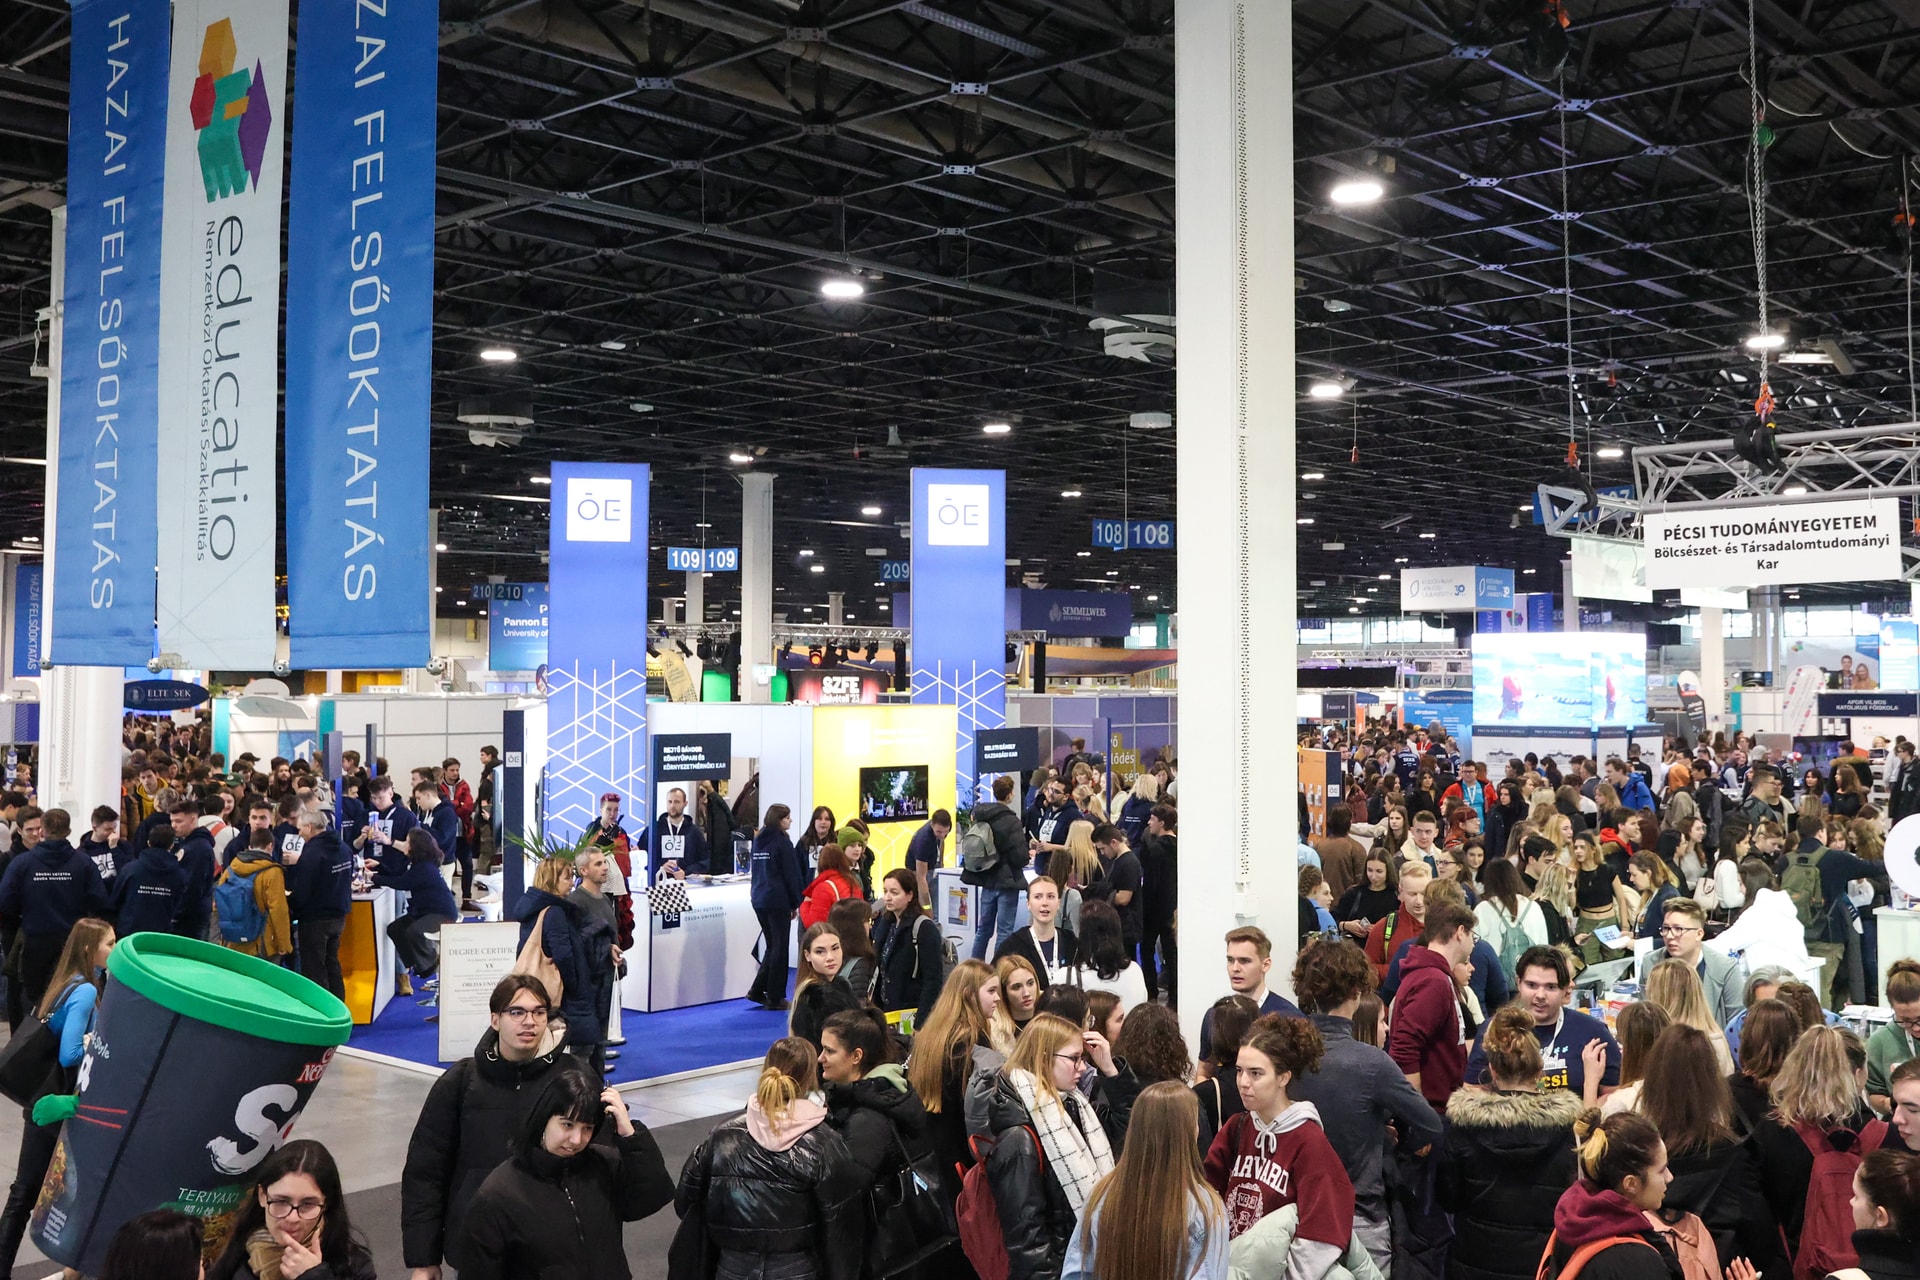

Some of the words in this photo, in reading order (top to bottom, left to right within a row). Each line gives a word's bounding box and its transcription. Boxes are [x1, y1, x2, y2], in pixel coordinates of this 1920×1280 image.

[103, 13, 131, 176] HAZAI
[203, 220, 216, 344] Nemzetközi
[343, 109, 391, 601] FELSŐOKTATÁS
[200, 348, 213, 433] Oktatási
[209, 215, 253, 561] educatio
[90, 195, 129, 610] FELSŐOKTATÁS
[197, 439, 210, 561] Szakkiállítás
[1096, 523, 1123, 544] 108
[1132, 524, 1170, 545] 108
[1663, 521, 1706, 541] PÉCSI
[1710, 514, 1877, 538] TUDOMÁNYEGYETEM
[1654, 544, 1722, 559] Bölcsészet-
[1725, 541, 1739, 555] és
[1740, 533, 1890, 553] Társadalomtudományi
[671, 550, 700, 569] 109
[708, 549, 736, 569] 109
[1756, 558, 1780, 570] Kar
[883, 562, 910, 579] 209
[29, 573, 40, 600] HAZAI
[473, 585, 492, 598] 210
[497, 586, 521, 599] 210
[1062, 606, 1107, 617] SEMMELWEIS
[1583, 614, 1601, 624] 309
[503, 617, 540, 626] Pannon
[1309, 620, 1325, 629] 310
[503, 629, 539, 639] University
[147, 689, 168, 697] ELTE
[174, 689, 192, 697] SEK
[822, 675, 860, 694] SZFE
[448, 948, 480, 956] DEGREE
[1542, 1069, 1569, 1088] csi
[1230, 1154, 1290, 1197] ARVARD
[178, 1187, 240, 1204] TERIYAKI
